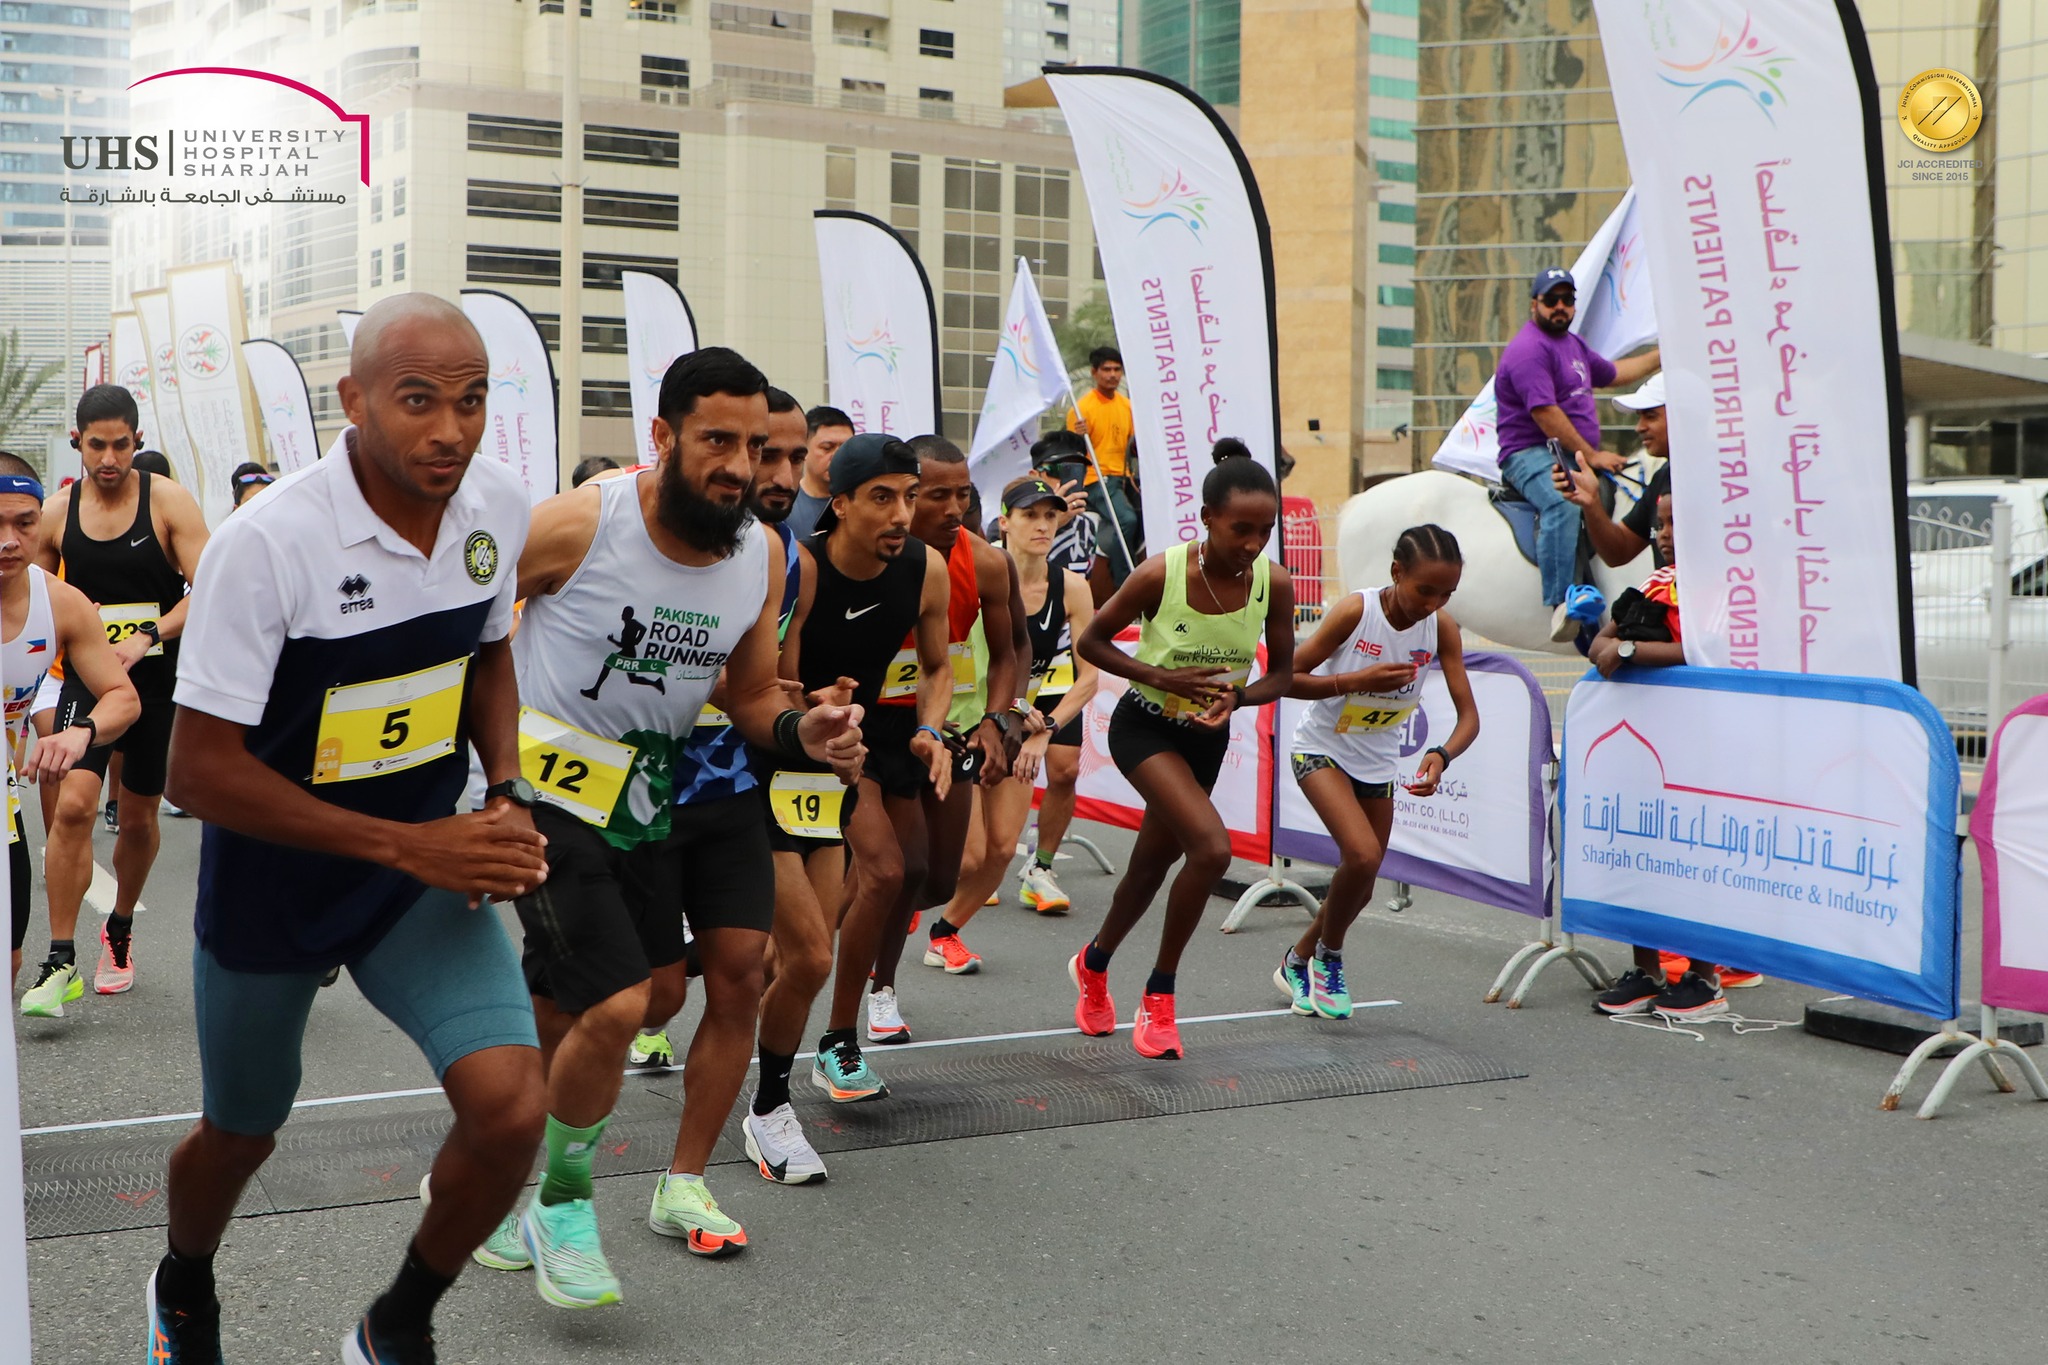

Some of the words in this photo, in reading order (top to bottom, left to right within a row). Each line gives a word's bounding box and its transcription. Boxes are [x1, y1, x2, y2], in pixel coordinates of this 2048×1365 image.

[340, 597, 374, 615] errea
[654, 606, 720, 629] PAKISTAN
[649, 621, 709, 648] ROAD
[614, 658, 640, 671] PRR
[643, 642, 728, 667] RUNNER
[379, 708, 411, 750] 5
[1361, 710, 1400, 725] 47
[538, 752, 589, 794] 12
[791, 794, 820, 822] 19
[1582, 843, 1631, 871] Sharjah
[1635, 852, 1699, 880] Chamber
[1702, 865, 1720, 884] of
[1722, 867, 1803, 901] Commerce
[1807, 884, 1823, 905] &
[1827, 887, 1898, 927] Industry
